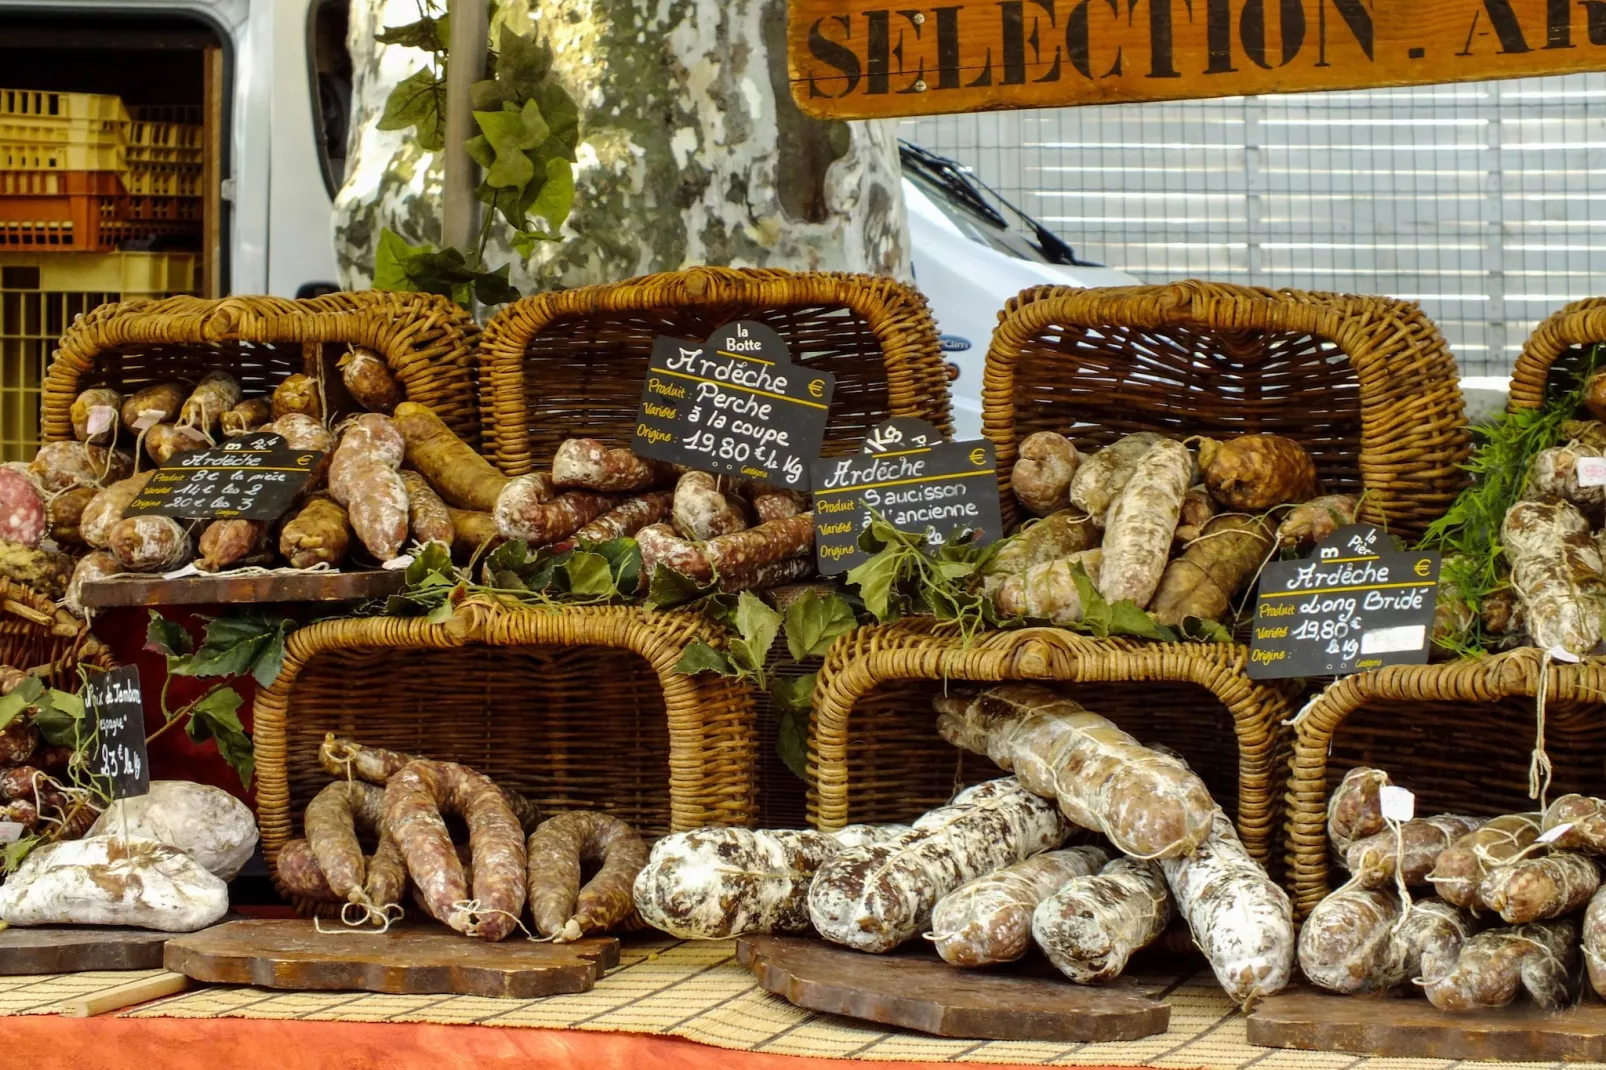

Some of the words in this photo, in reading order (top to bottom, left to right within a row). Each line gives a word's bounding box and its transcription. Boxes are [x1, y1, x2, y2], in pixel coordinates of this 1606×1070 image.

[808, 0, 1374, 99] SELECTION
[737, 323, 748, 338] la
[726, 338, 762, 352] Botte
[666, 347, 788, 394] Ardèche
[648, 378, 686, 398] Produit
[697, 382, 772, 420] Perche
[706, 410, 727, 428] la
[731, 420, 790, 447] coupe
[637, 424, 672, 444] Origine
[763, 449, 778, 469] le
[782, 455, 803, 483] Kg
[230, 471, 244, 481] la
[221, 483, 240, 494] les
[244, 484, 263, 495] 2
[816, 499, 854, 514] Produit
[864, 483, 966, 507] Saucisson
[210, 497, 230, 508] les
[237, 498, 252, 511] 3
[1365, 528, 1378, 544] la
[820, 545, 854, 560] Origine
[1286, 561, 1389, 589] Ardèche
[1260, 603, 1295, 618] Produit
[1300, 595, 1356, 622] Long
[1363, 588, 1429, 610] Bridé
[1252, 649, 1285, 665] Origine
